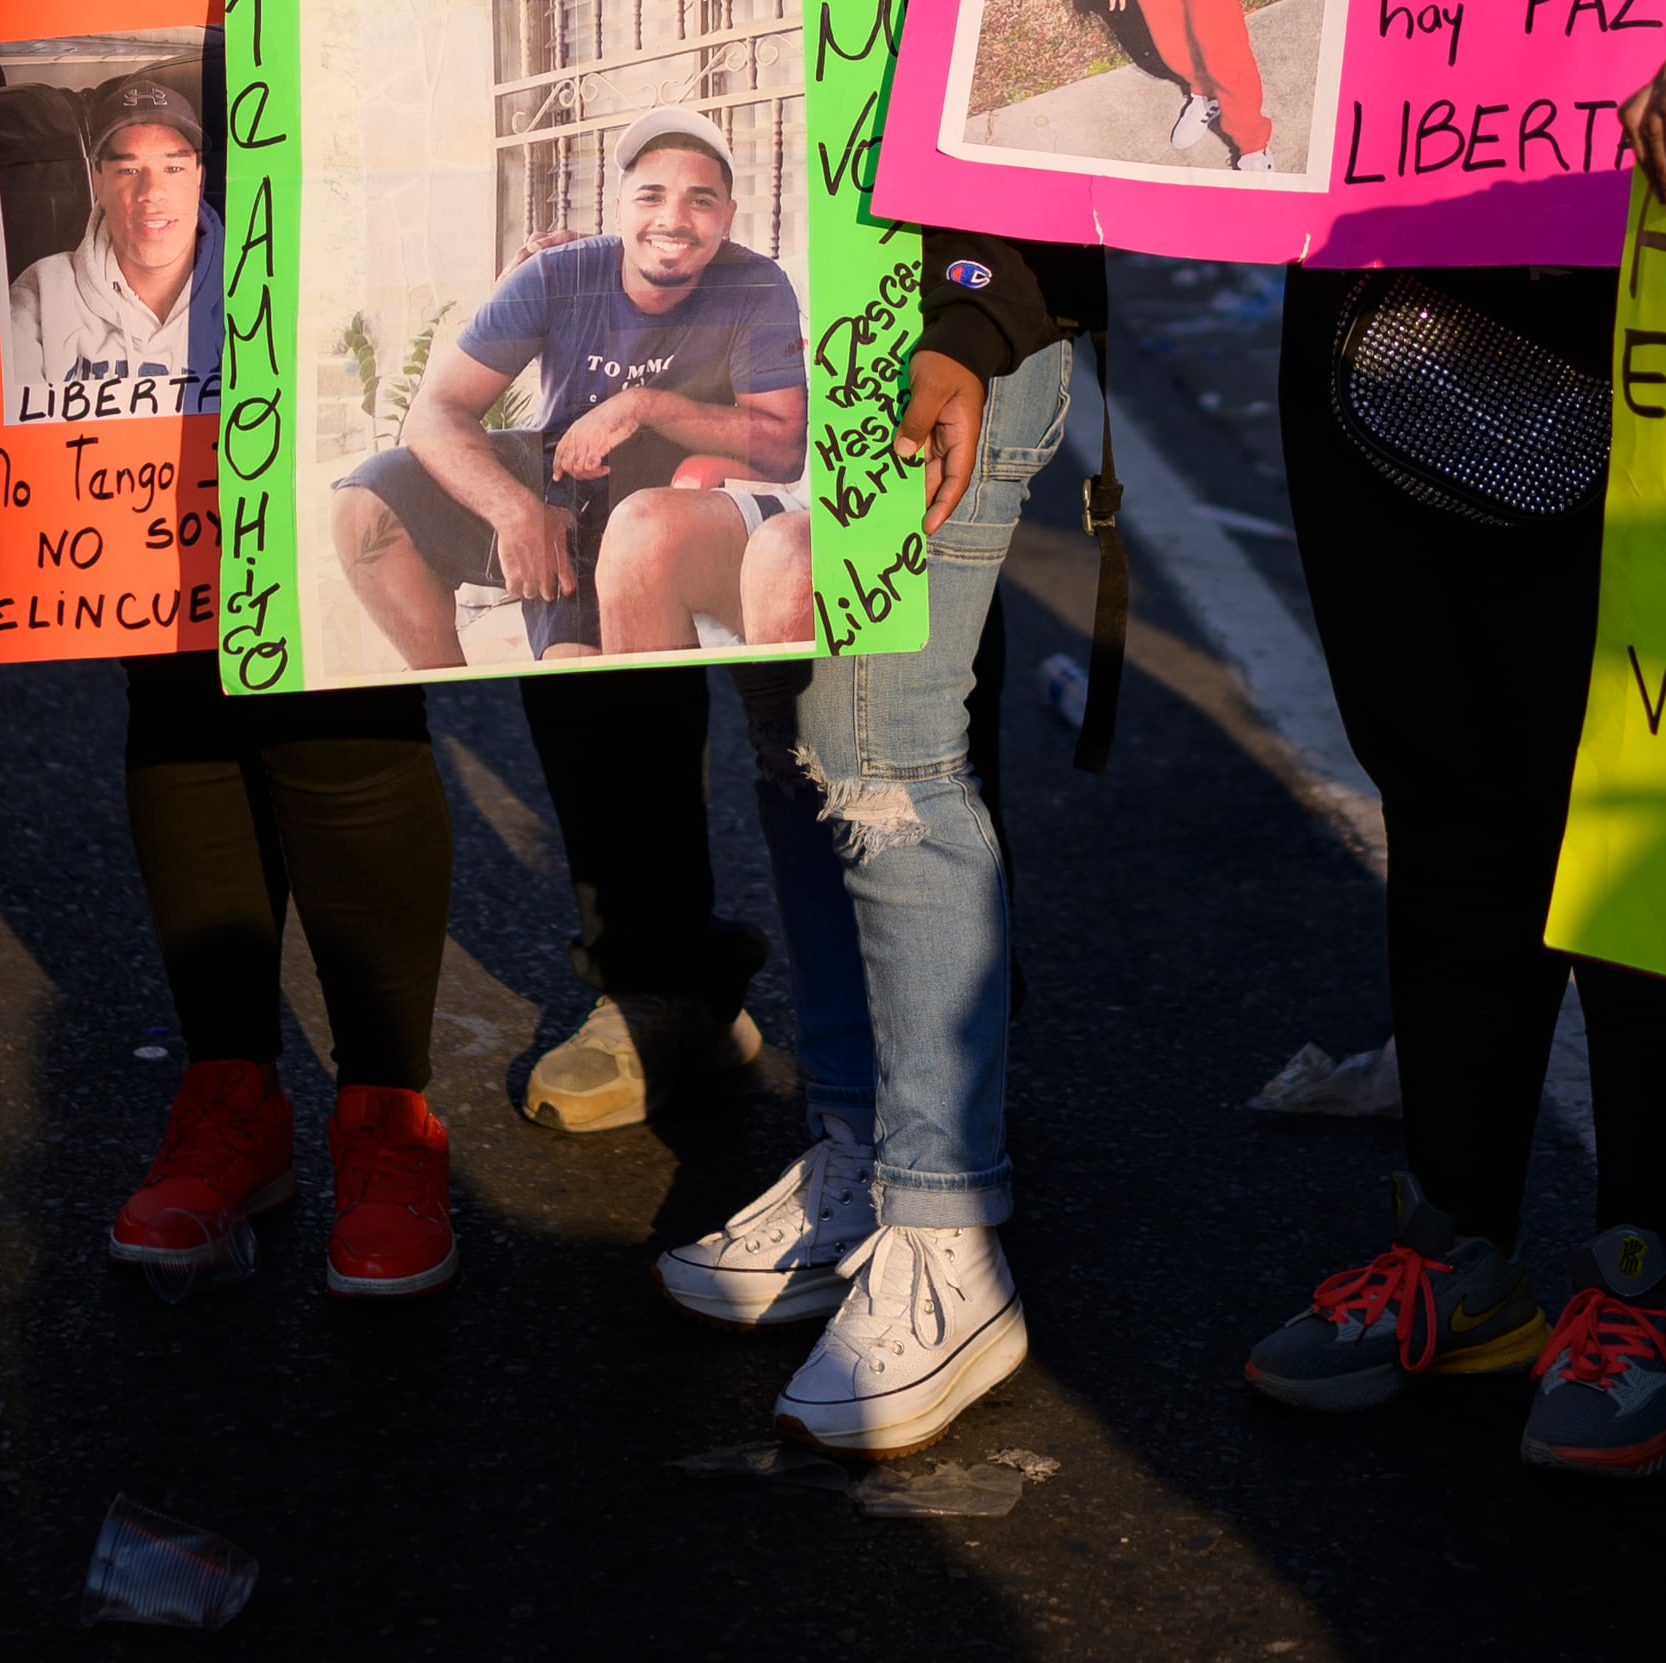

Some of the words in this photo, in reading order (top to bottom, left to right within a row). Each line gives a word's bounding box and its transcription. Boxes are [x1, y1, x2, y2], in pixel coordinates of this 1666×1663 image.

[65, 434, 175, 512] Tengo
[38, 527, 103, 570] NO
[146, 509, 221, 550] SOY
[815, 532, 927, 656] Libre
